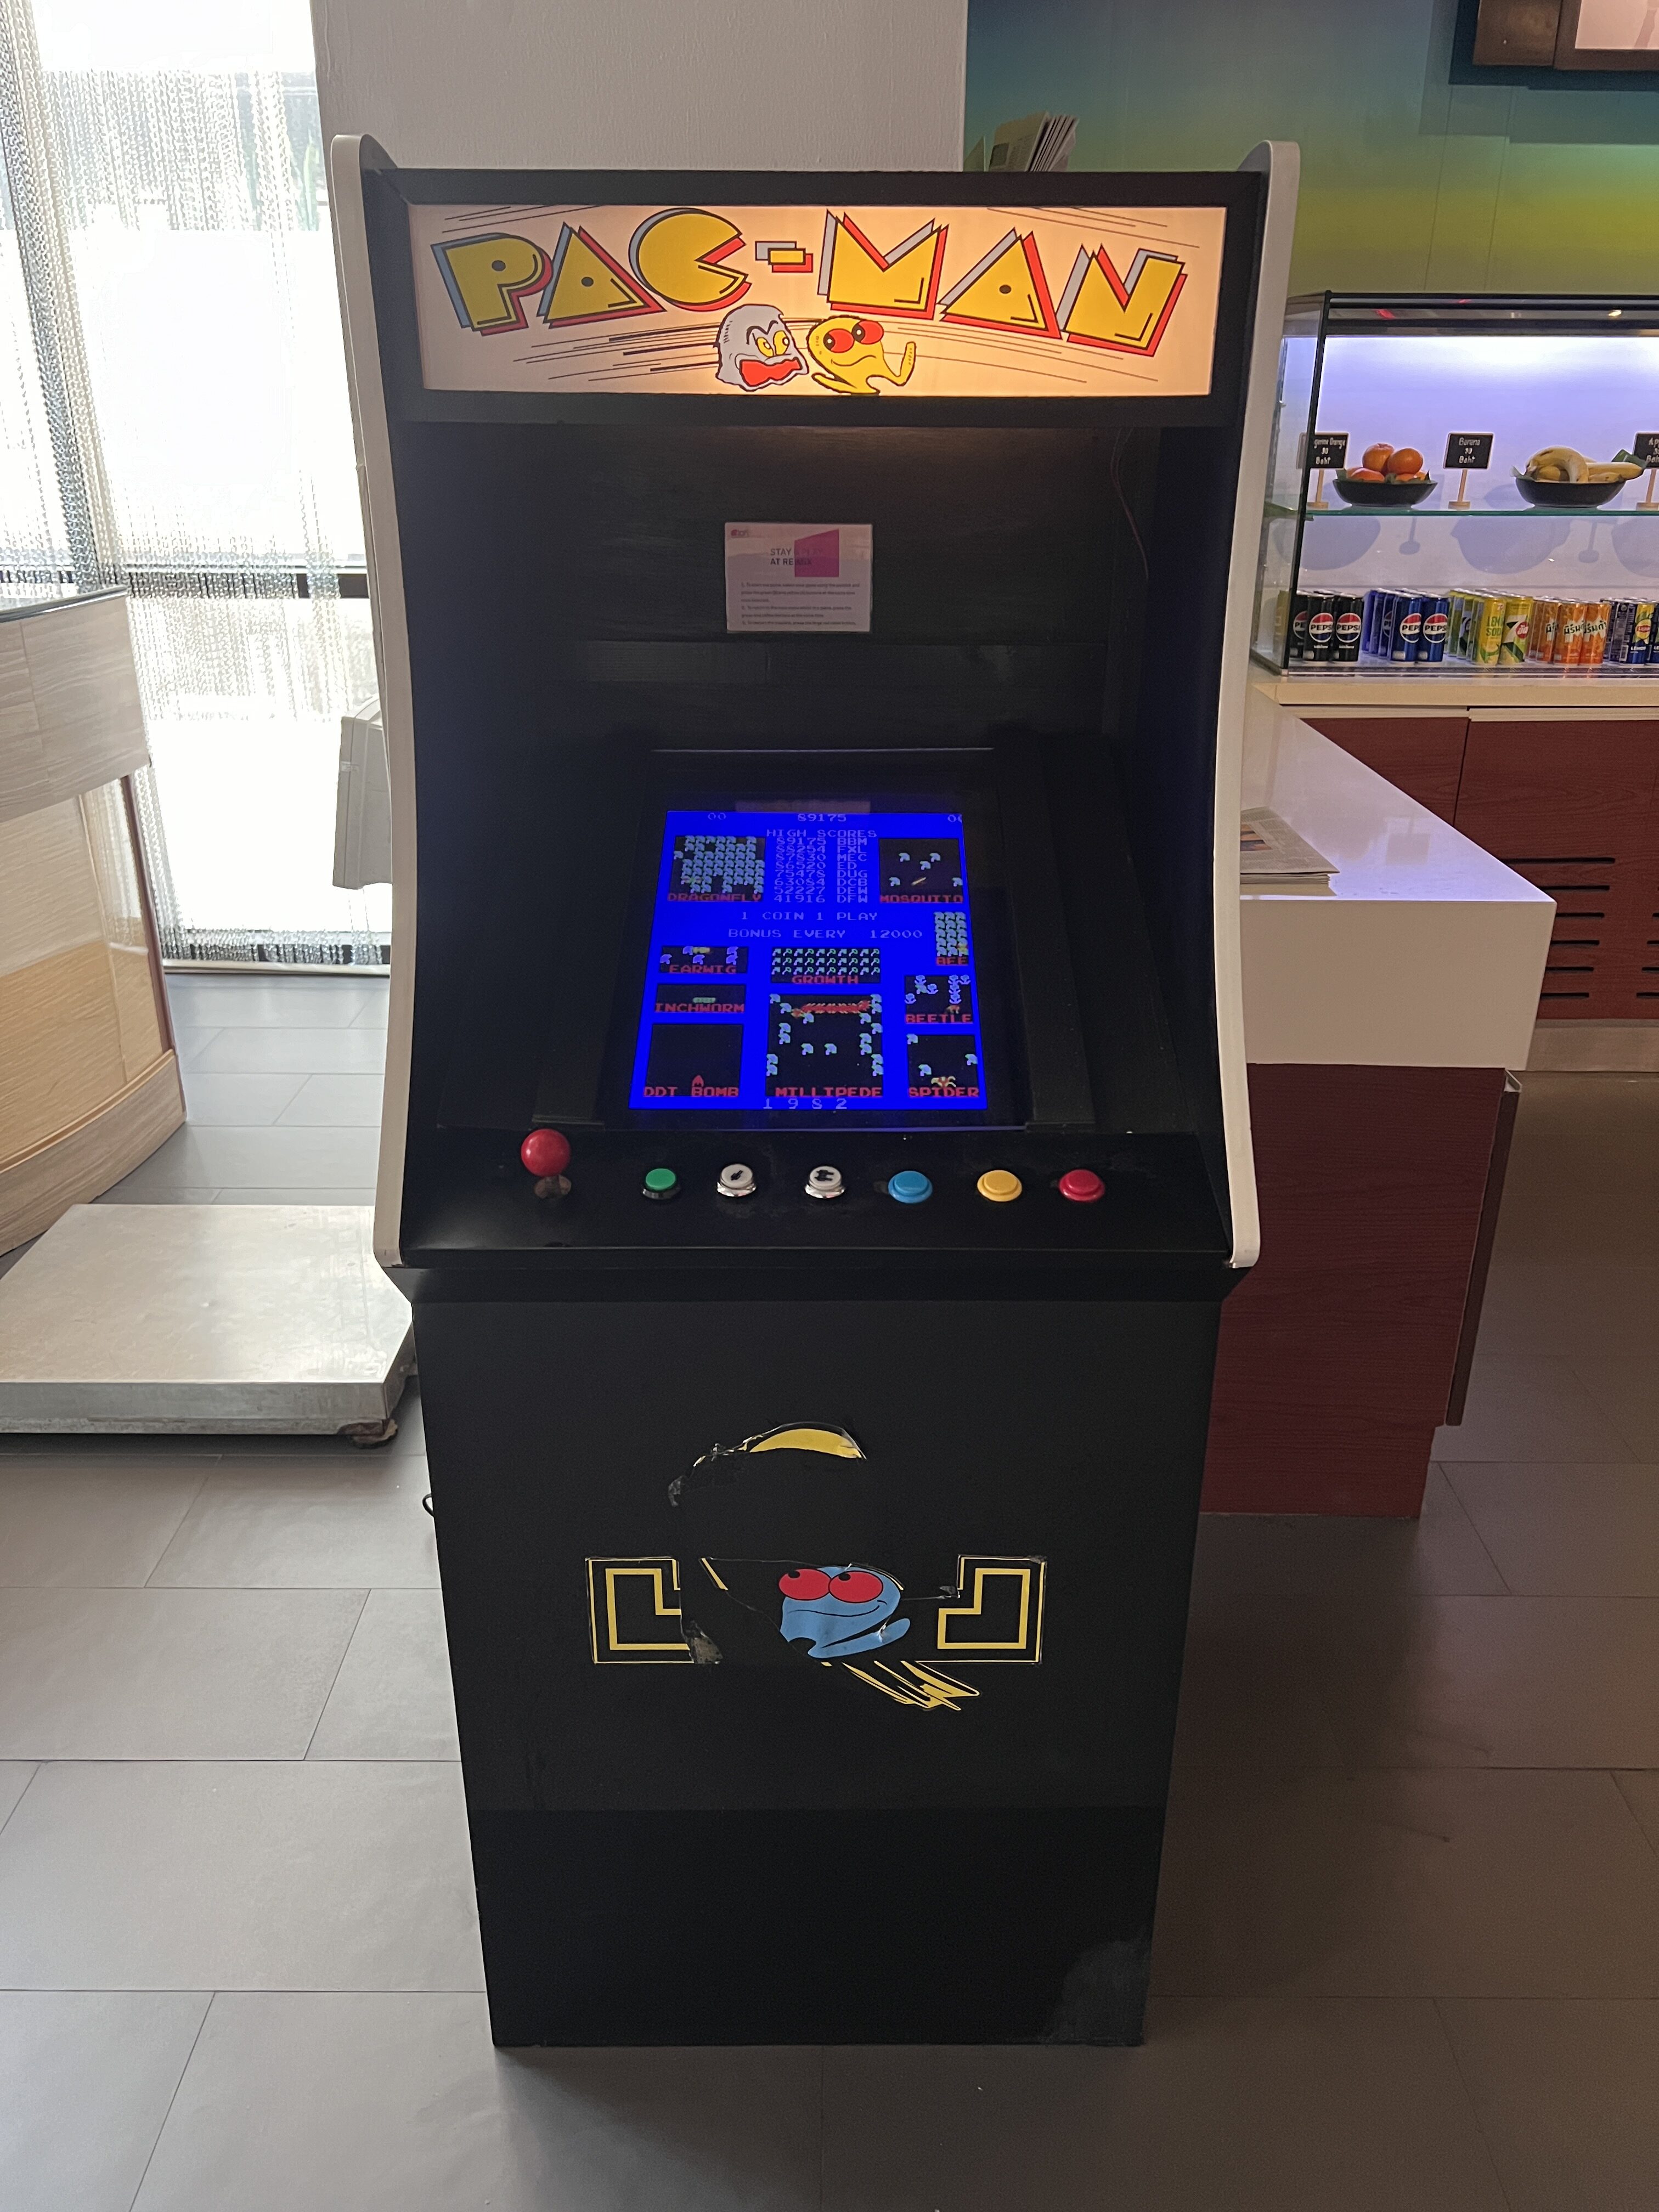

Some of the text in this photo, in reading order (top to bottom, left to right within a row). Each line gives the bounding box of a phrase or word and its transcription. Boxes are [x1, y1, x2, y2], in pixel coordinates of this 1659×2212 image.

[431, 208, 1189, 356] PAC-MAN
[798, 814, 847, 822] 89175
[766, 829, 877, 838] HIGH SCORES
[777, 837, 867, 845] 89175 BBM
[775, 870, 867, 878] 75478 DUG
[668, 893, 762, 902] DRAGONFLY
[774, 895, 867, 903] 41916 DFW
[880, 895, 963, 903] MOSQUITO
[762, 912, 804, 920] COIN
[728, 929, 923, 938] BONUS EVERY 12000
[936, 957, 968, 966] BEE
[669, 964, 737, 973] EARWIG
[792, 975, 859, 984] GROWTH
[655, 1003, 744, 1012] INCHWORM
[906, 1014, 973, 1024] BEETLE
[644, 1087, 739, 1097] DDT BOMB
[775, 1087, 882, 1097] MILLIPEDE
[908, 1087, 979, 1097] SPIDER
